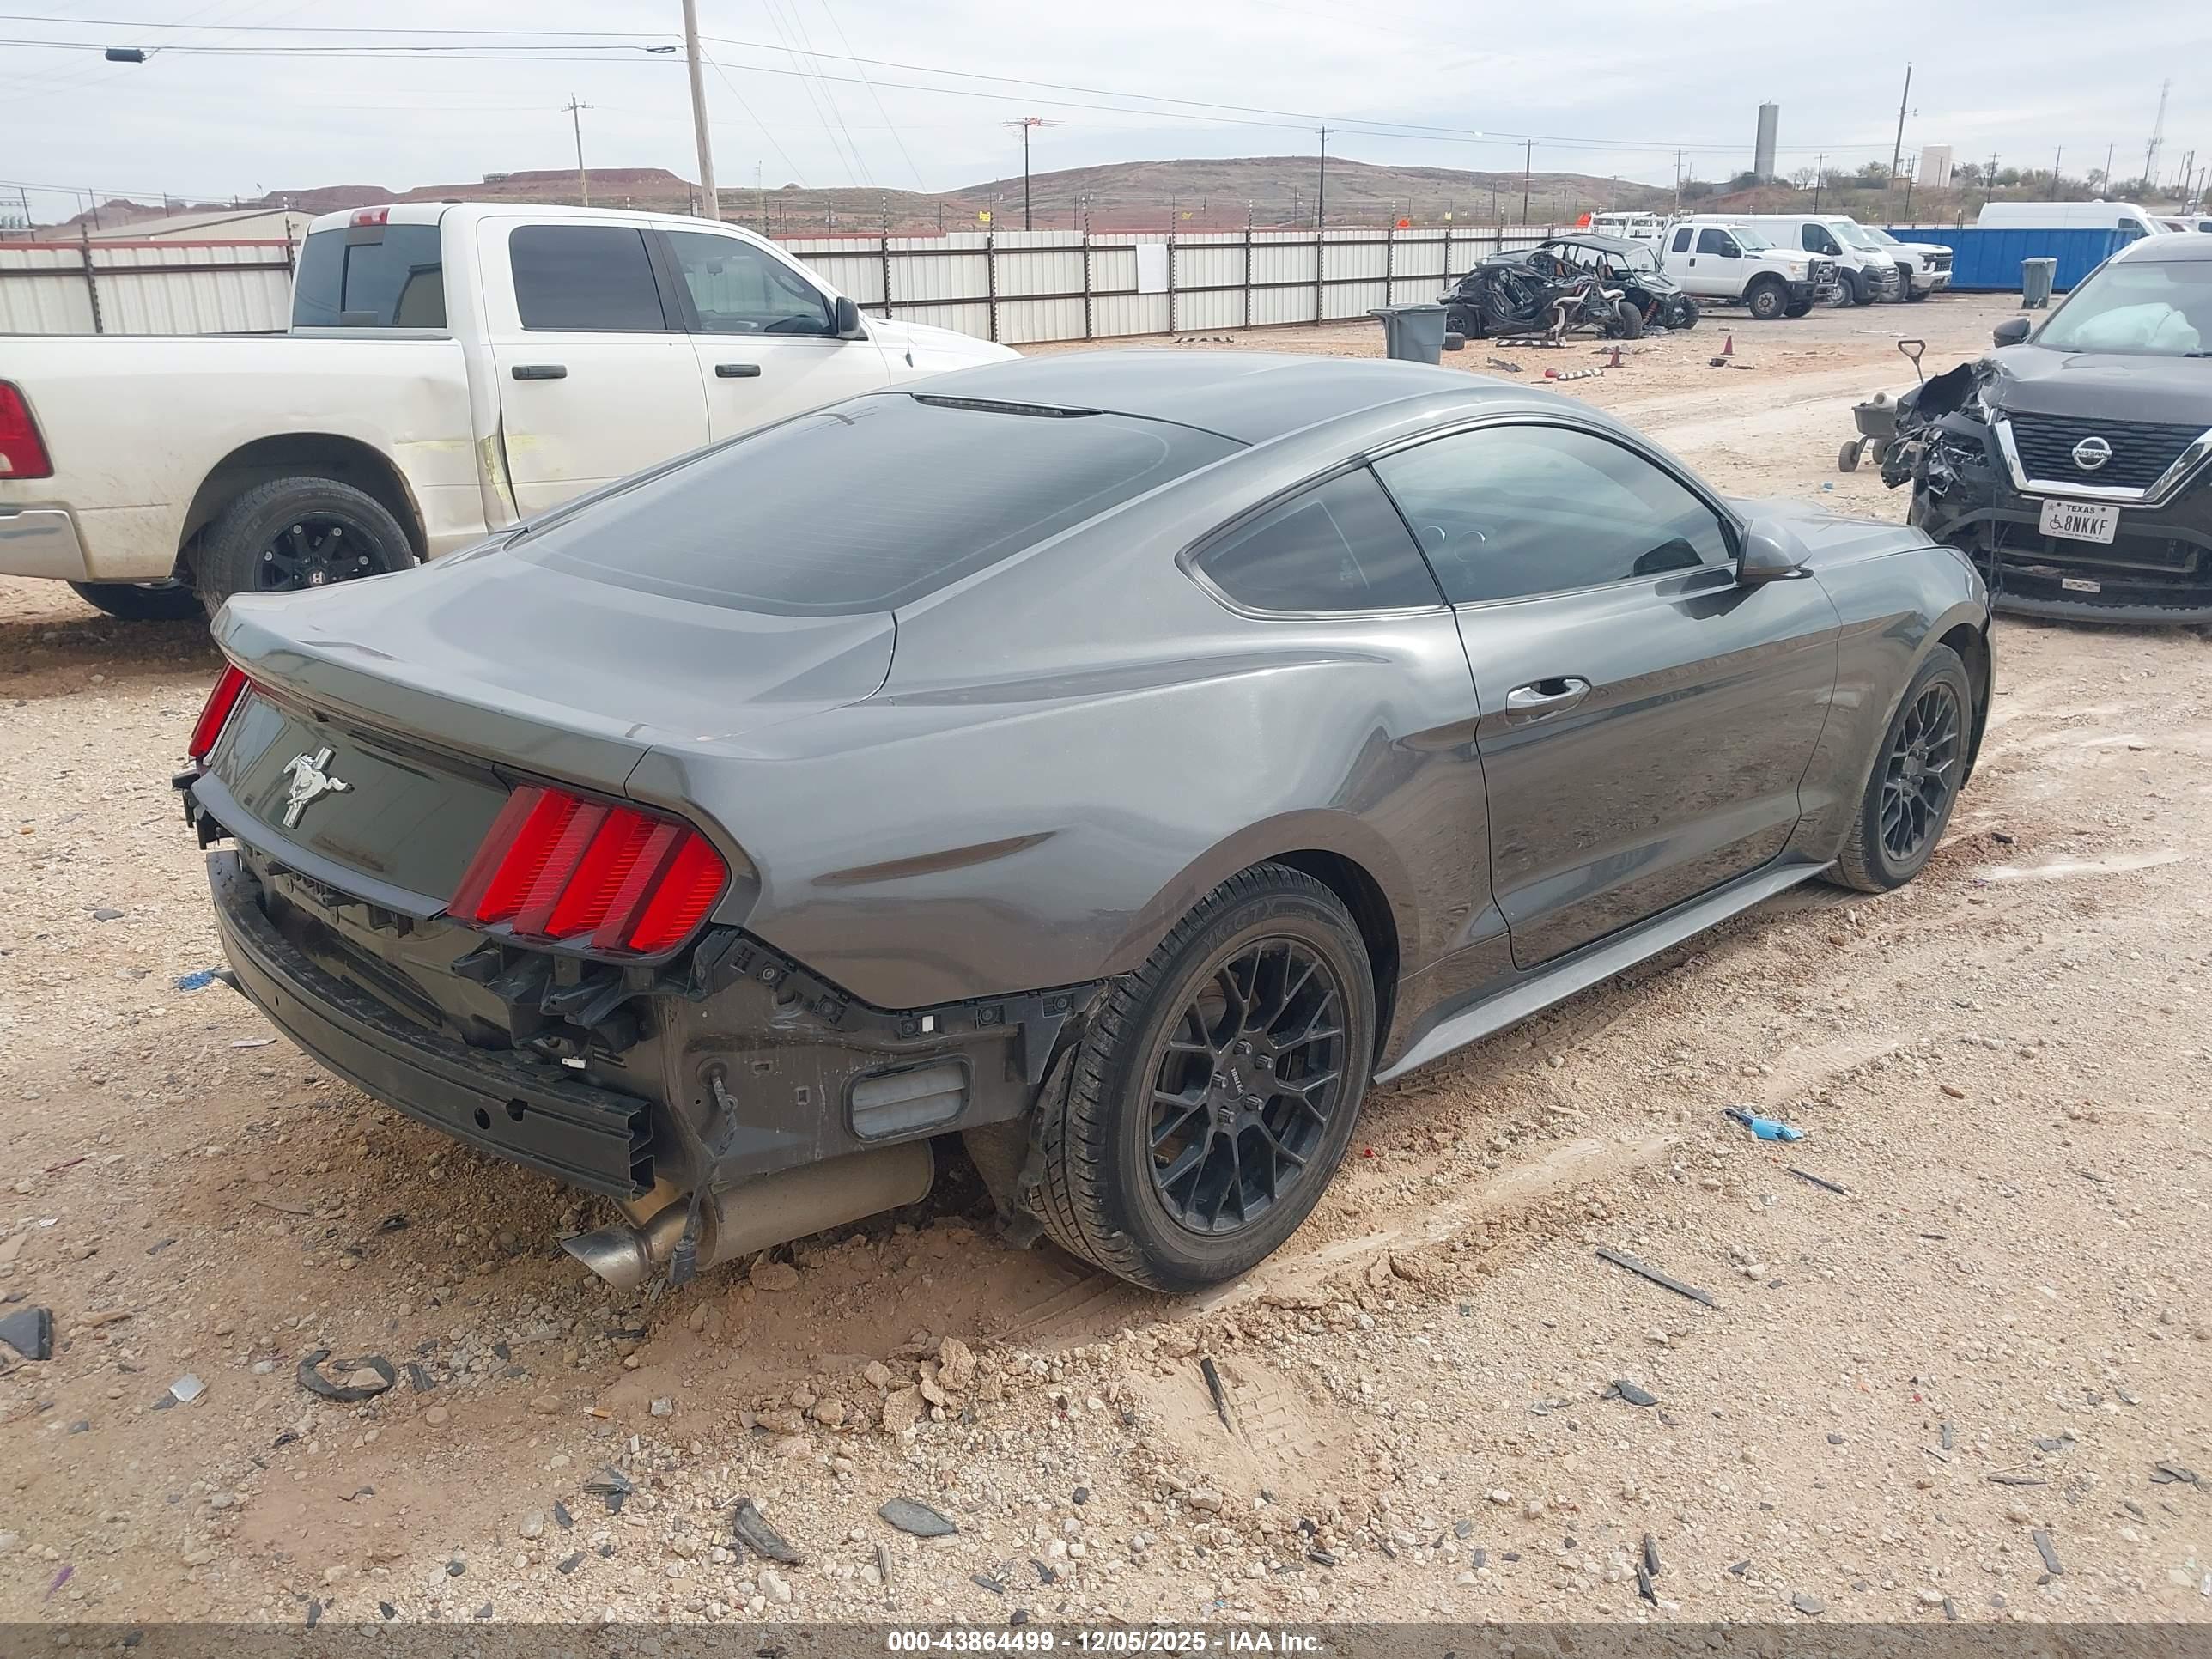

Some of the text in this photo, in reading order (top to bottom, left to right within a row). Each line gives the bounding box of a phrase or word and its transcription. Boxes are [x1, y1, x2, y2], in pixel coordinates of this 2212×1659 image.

[2074, 449, 2108, 458] NISSAN
[2066, 504, 2095, 514] TEXAS
[2064, 515, 2108, 535] 8NKKF
